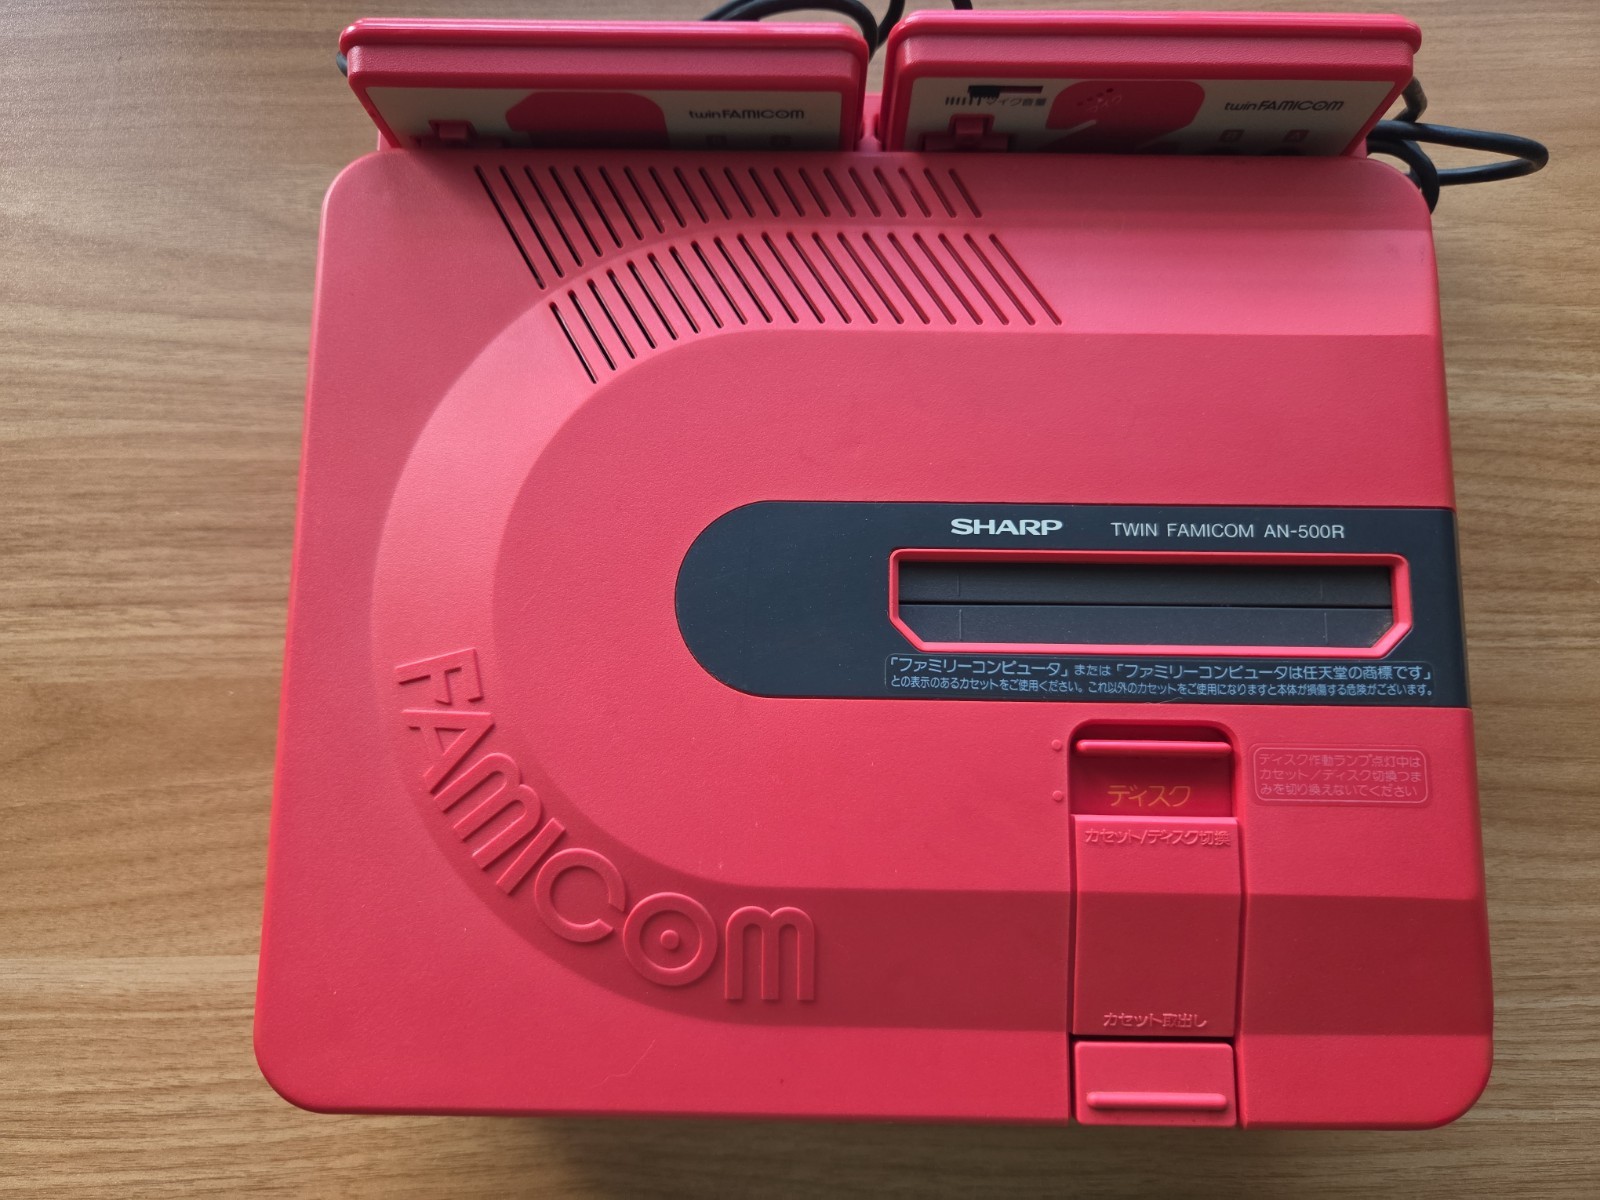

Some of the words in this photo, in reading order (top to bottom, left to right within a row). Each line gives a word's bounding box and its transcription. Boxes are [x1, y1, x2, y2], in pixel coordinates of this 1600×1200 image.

[950, 517, 1063, 536] SHARP
[1110, 522, 1158, 537] TWIN
[1167, 523, 1254, 538] FAMICOM
[1264, 524, 1345, 539] AN-500R
[1107, 784, 1191, 807] ディスク
[395, 648, 816, 1001] FAMICOM
[1084, 828, 1232, 847] カセット/ディスク切換
[1103, 1012, 1208, 1028] カセット取出し
